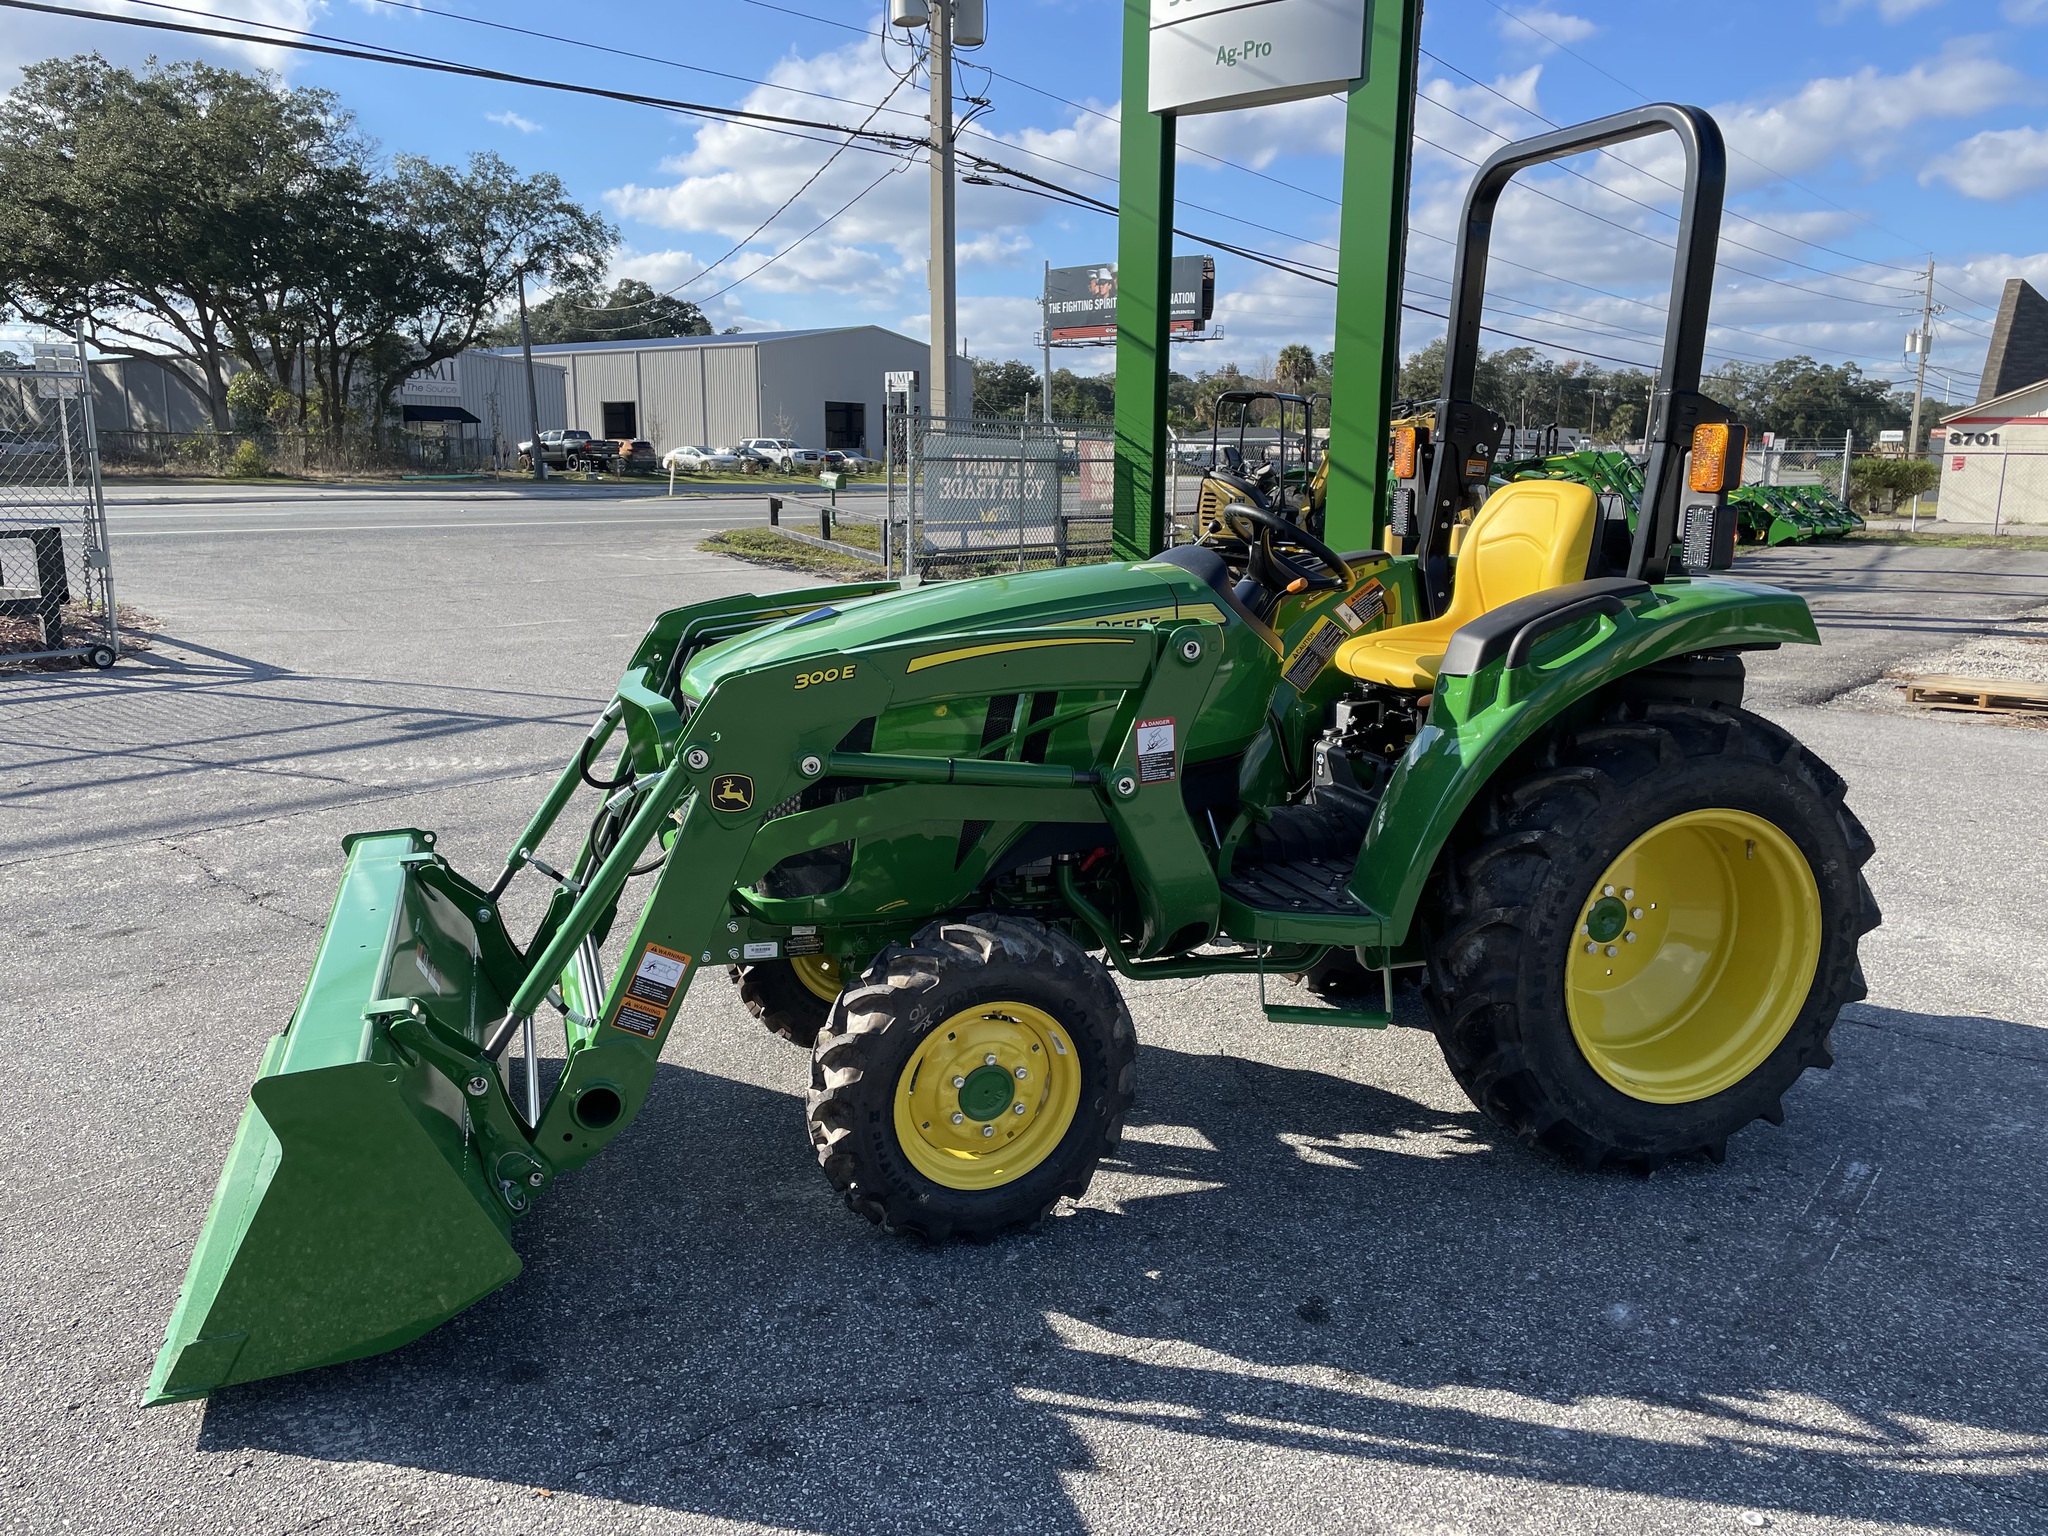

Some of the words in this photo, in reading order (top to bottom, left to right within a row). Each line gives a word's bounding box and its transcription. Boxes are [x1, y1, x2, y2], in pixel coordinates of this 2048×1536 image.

[1216, 40, 1272, 67] Ag-Pro
[1049, 302, 1061, 314] THE
[1062, 299, 1094, 313] FIGHTING
[1094, 297, 1118, 310] SPIRIT
[406, 382, 424, 392] The
[425, 384, 457, 393] Source
[1949, 432, 2000, 446] 8701
[1296, 631, 1316, 655] CAUTION
[794, 668, 839, 690] 300
[842, 664, 856, 680] E
[1148, 719, 1170, 727] DANGER
[658, 949, 686, 962] WARNING
[633, 1003, 661, 1015] WARNING
